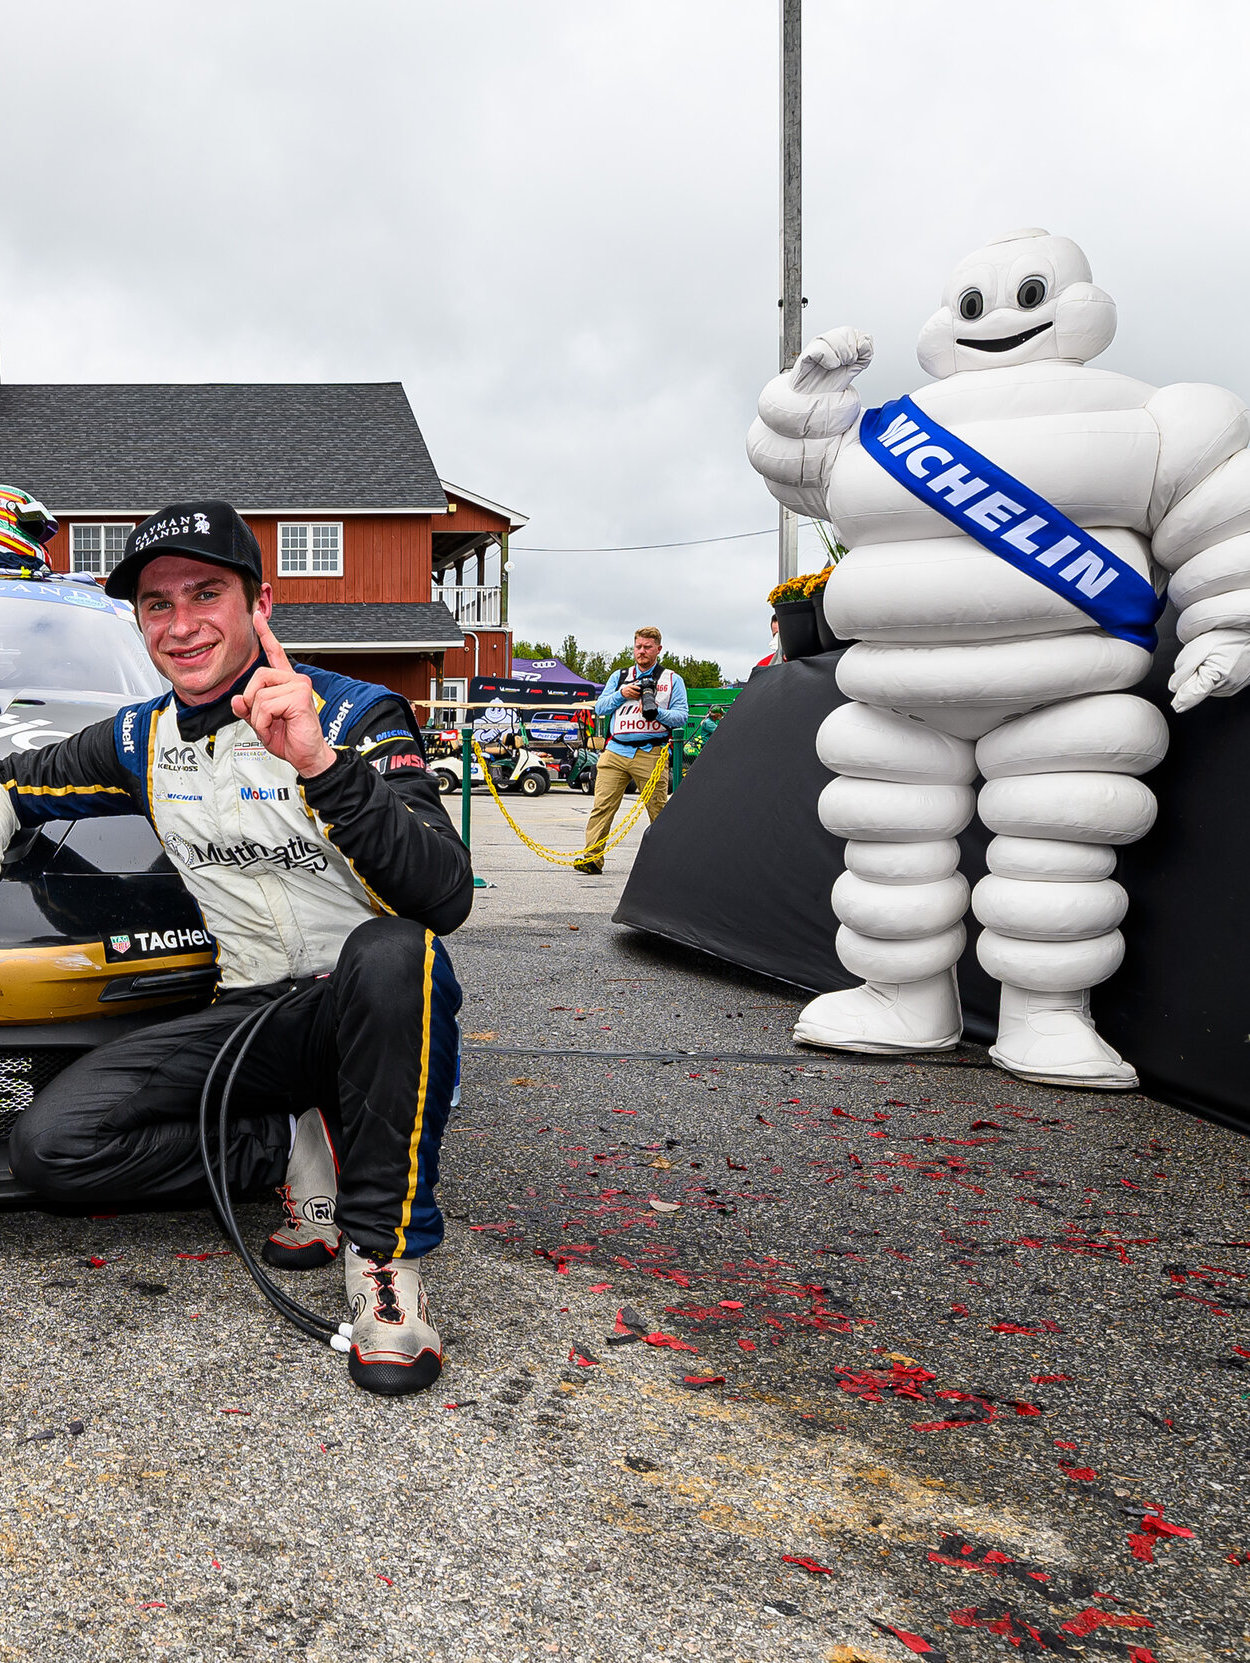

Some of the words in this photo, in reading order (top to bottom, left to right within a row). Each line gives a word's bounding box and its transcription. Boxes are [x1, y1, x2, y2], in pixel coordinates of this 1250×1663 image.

[876, 412, 1120, 600] MICHELIN
[134, 525, 190, 552] ISLANDS
[135, 516, 191, 546] CAYMAN
[122, 710, 138, 754] Sabelt
[619, 719, 661, 731] PHOTO
[167, 793, 203, 801] MICHELIN
[240, 787, 276, 801] Mobil
